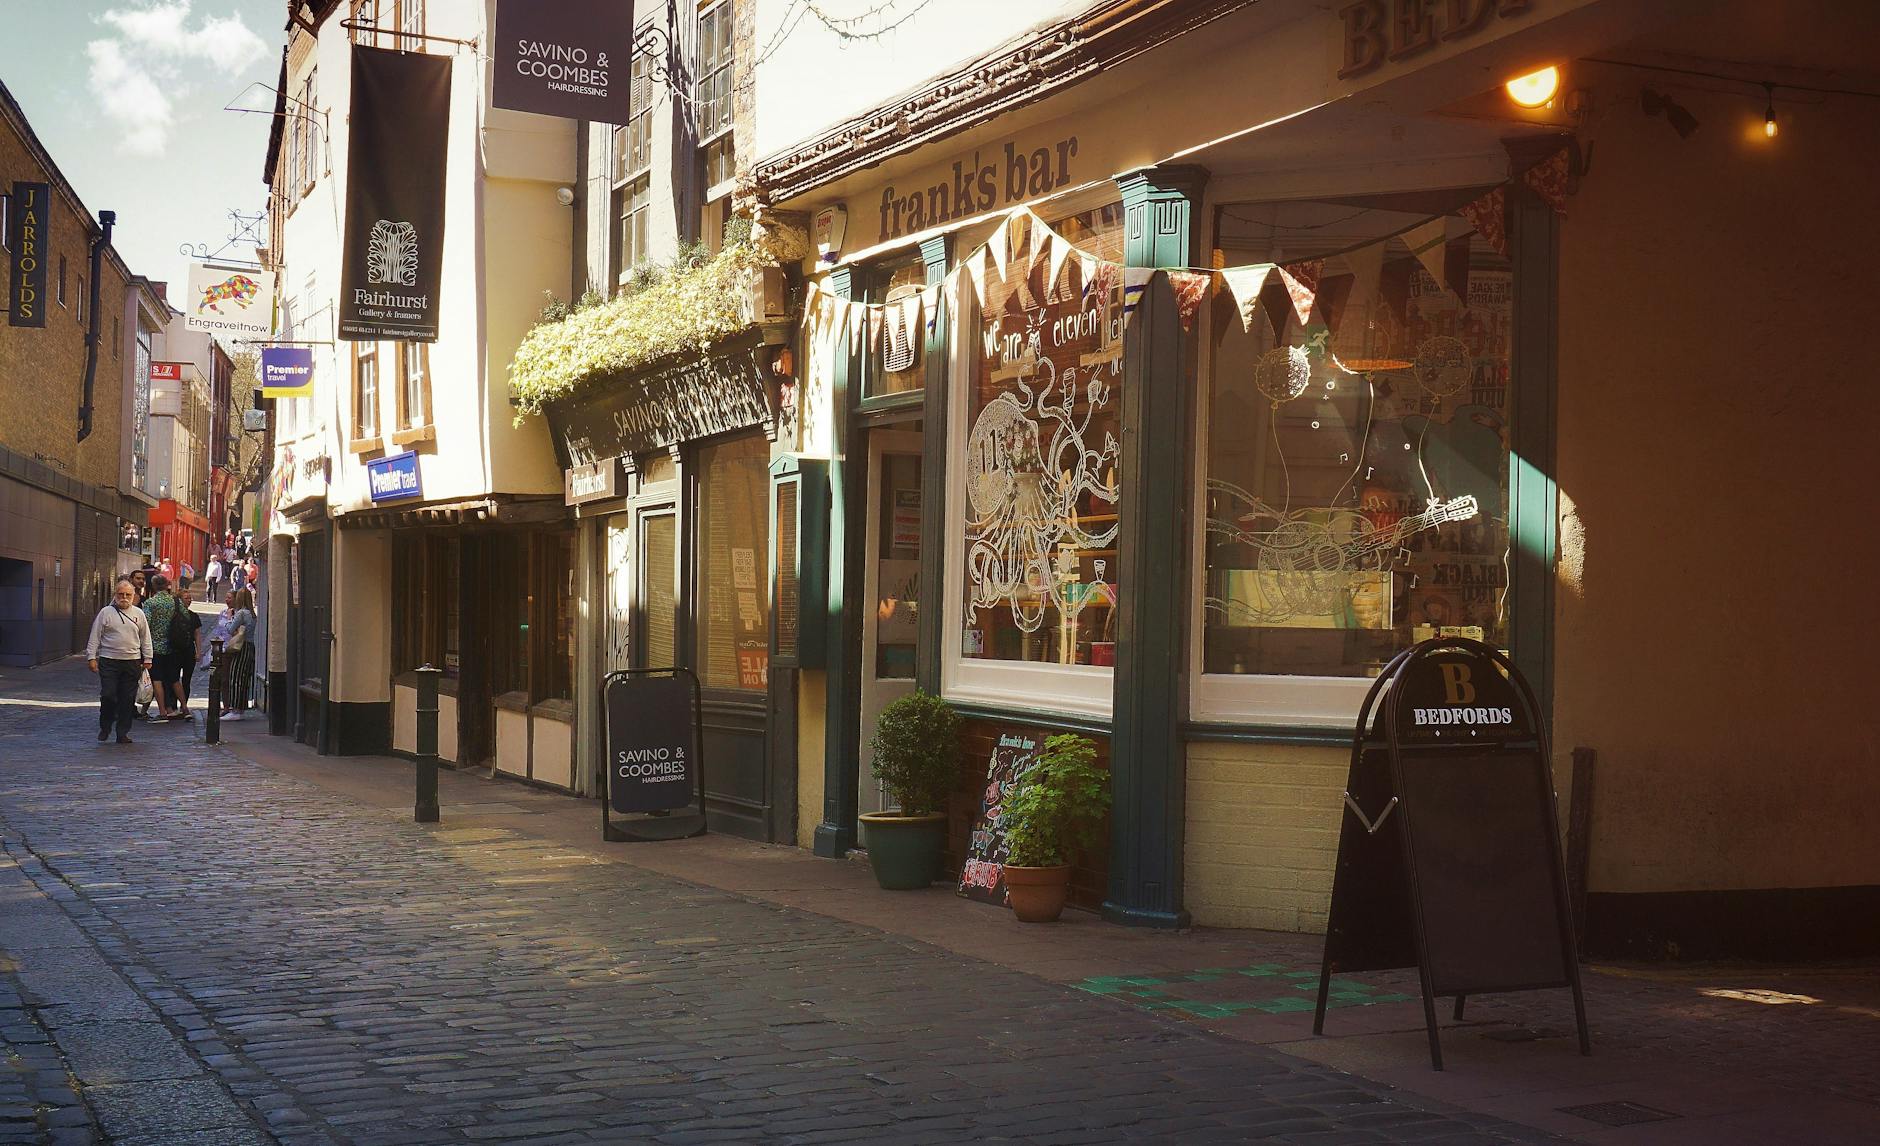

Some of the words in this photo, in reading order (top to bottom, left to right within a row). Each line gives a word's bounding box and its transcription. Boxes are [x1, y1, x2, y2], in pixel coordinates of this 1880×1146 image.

[1337, 0, 1528, 80] BED
[518, 39, 588, 64] SAVINO
[596, 52, 609, 68] &
[516, 59, 609, 87] COOMBES
[547, 81, 608, 97] HAIRDRESSING
[878, 151, 998, 242] frank's
[1003, 135, 1079, 203] bar
[19, 189, 37, 318] JARROLDS
[353, 288, 428, 309] Fairhurst
[188, 316, 269, 333] Engraveitnow
[358, 307, 386, 319] Gallery
[394, 311, 422, 320] framers
[982, 319, 1001, 360] we
[1001, 330, 1022, 364] are
[1052, 308, 1098, 348] eleven
[266, 364, 309, 375] Premier
[613, 400, 662, 438] SAVINO
[370, 463, 402, 495] Premier
[401, 466, 417, 489] travel
[1438, 662, 1476, 704] B
[1413, 707, 1512, 726] BEDFORDS
[618, 748, 670, 764] SAVINO
[675, 746, 685, 758] &
[618, 760, 686, 778] COOMBES
[642, 773, 686, 783] HAIRDRESSING
